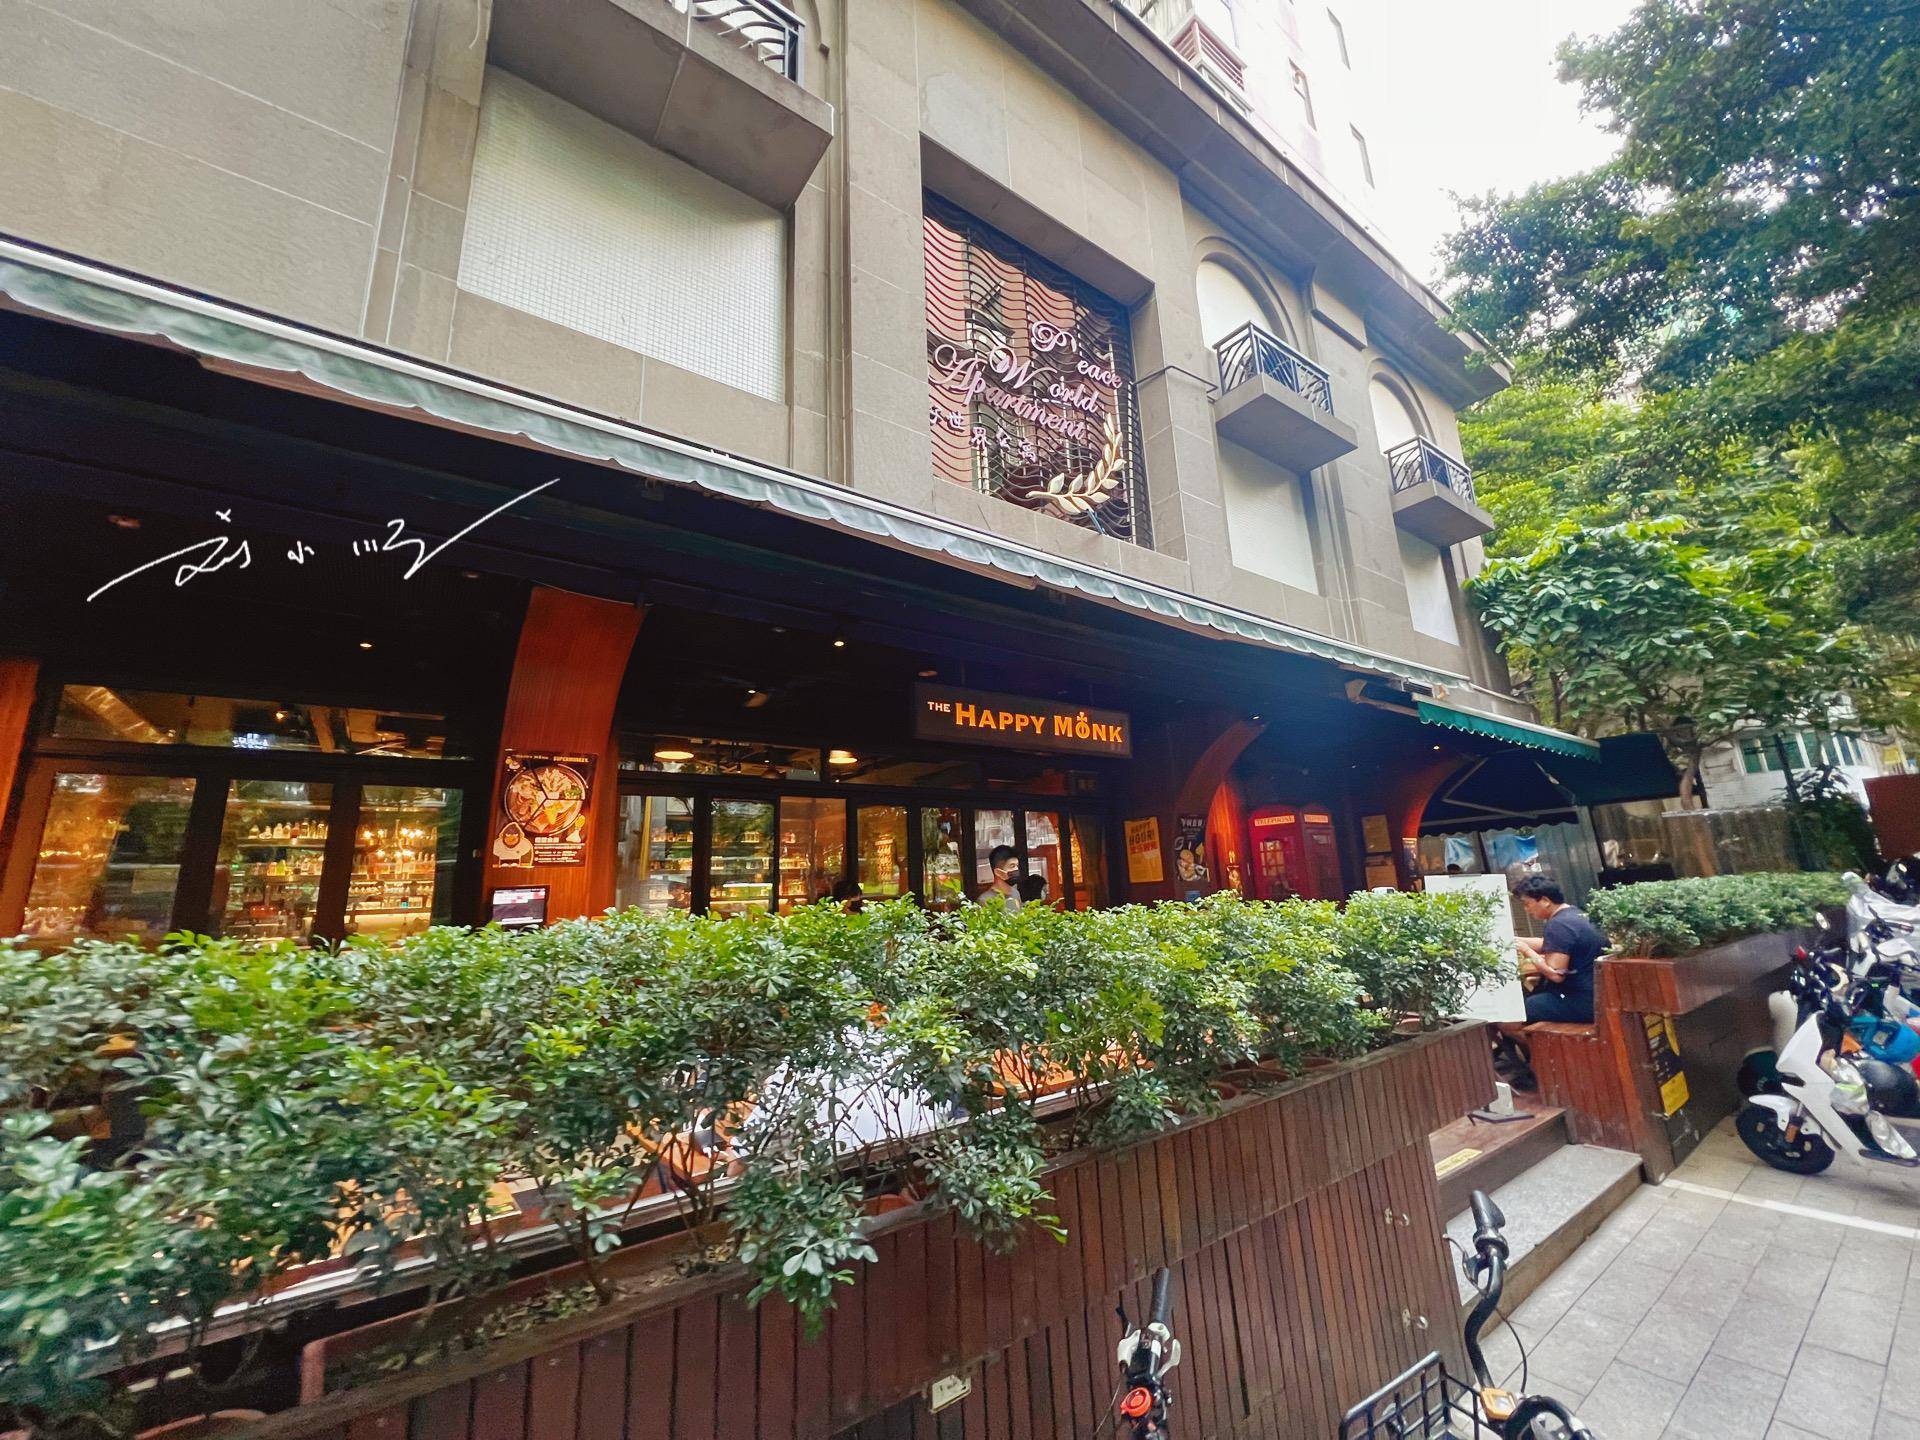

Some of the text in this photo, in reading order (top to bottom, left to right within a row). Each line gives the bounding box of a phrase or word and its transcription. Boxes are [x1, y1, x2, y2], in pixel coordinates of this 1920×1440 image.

[989, 343, 1099, 413] World
[1031, 321, 1122, 389] Peace
[928, 344, 1086, 440] Apartment
[927, 701, 1123, 743] THE HAPPY MONK
